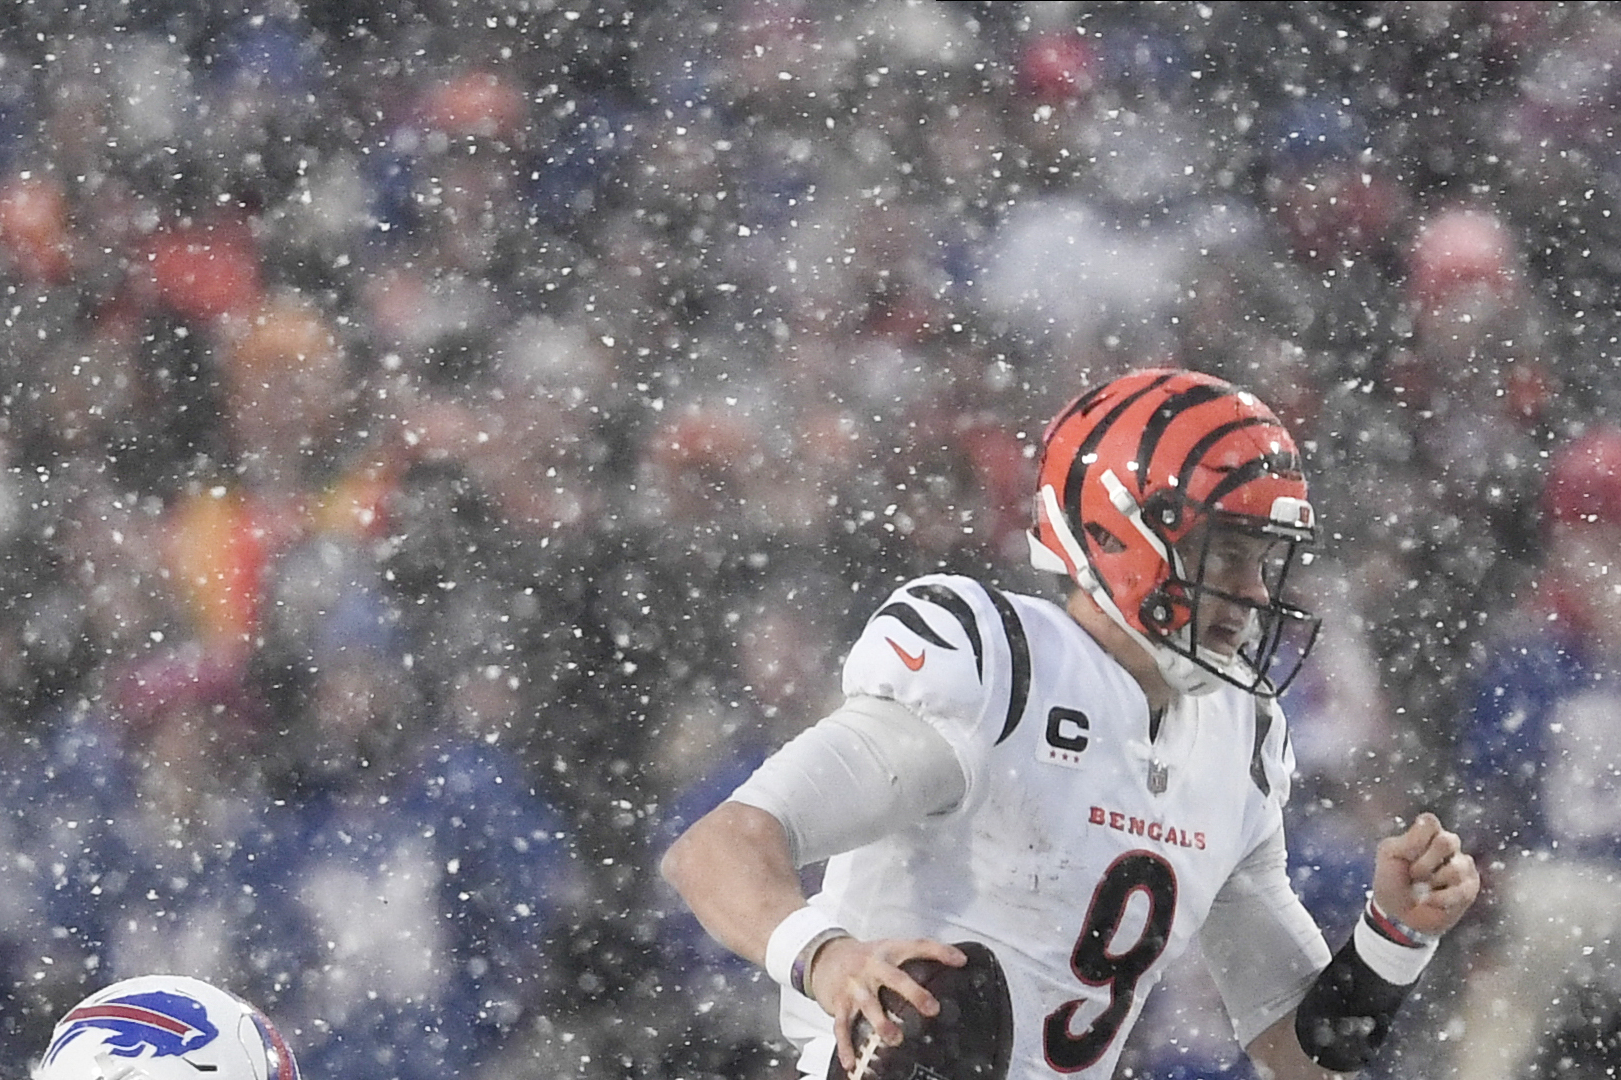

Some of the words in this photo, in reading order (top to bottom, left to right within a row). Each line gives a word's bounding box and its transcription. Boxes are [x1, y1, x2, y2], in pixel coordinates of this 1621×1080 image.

[1045, 705, 1090, 753] C
[1088, 806, 1206, 850] BENGALS
[1043, 848, 1178, 1073] 9
